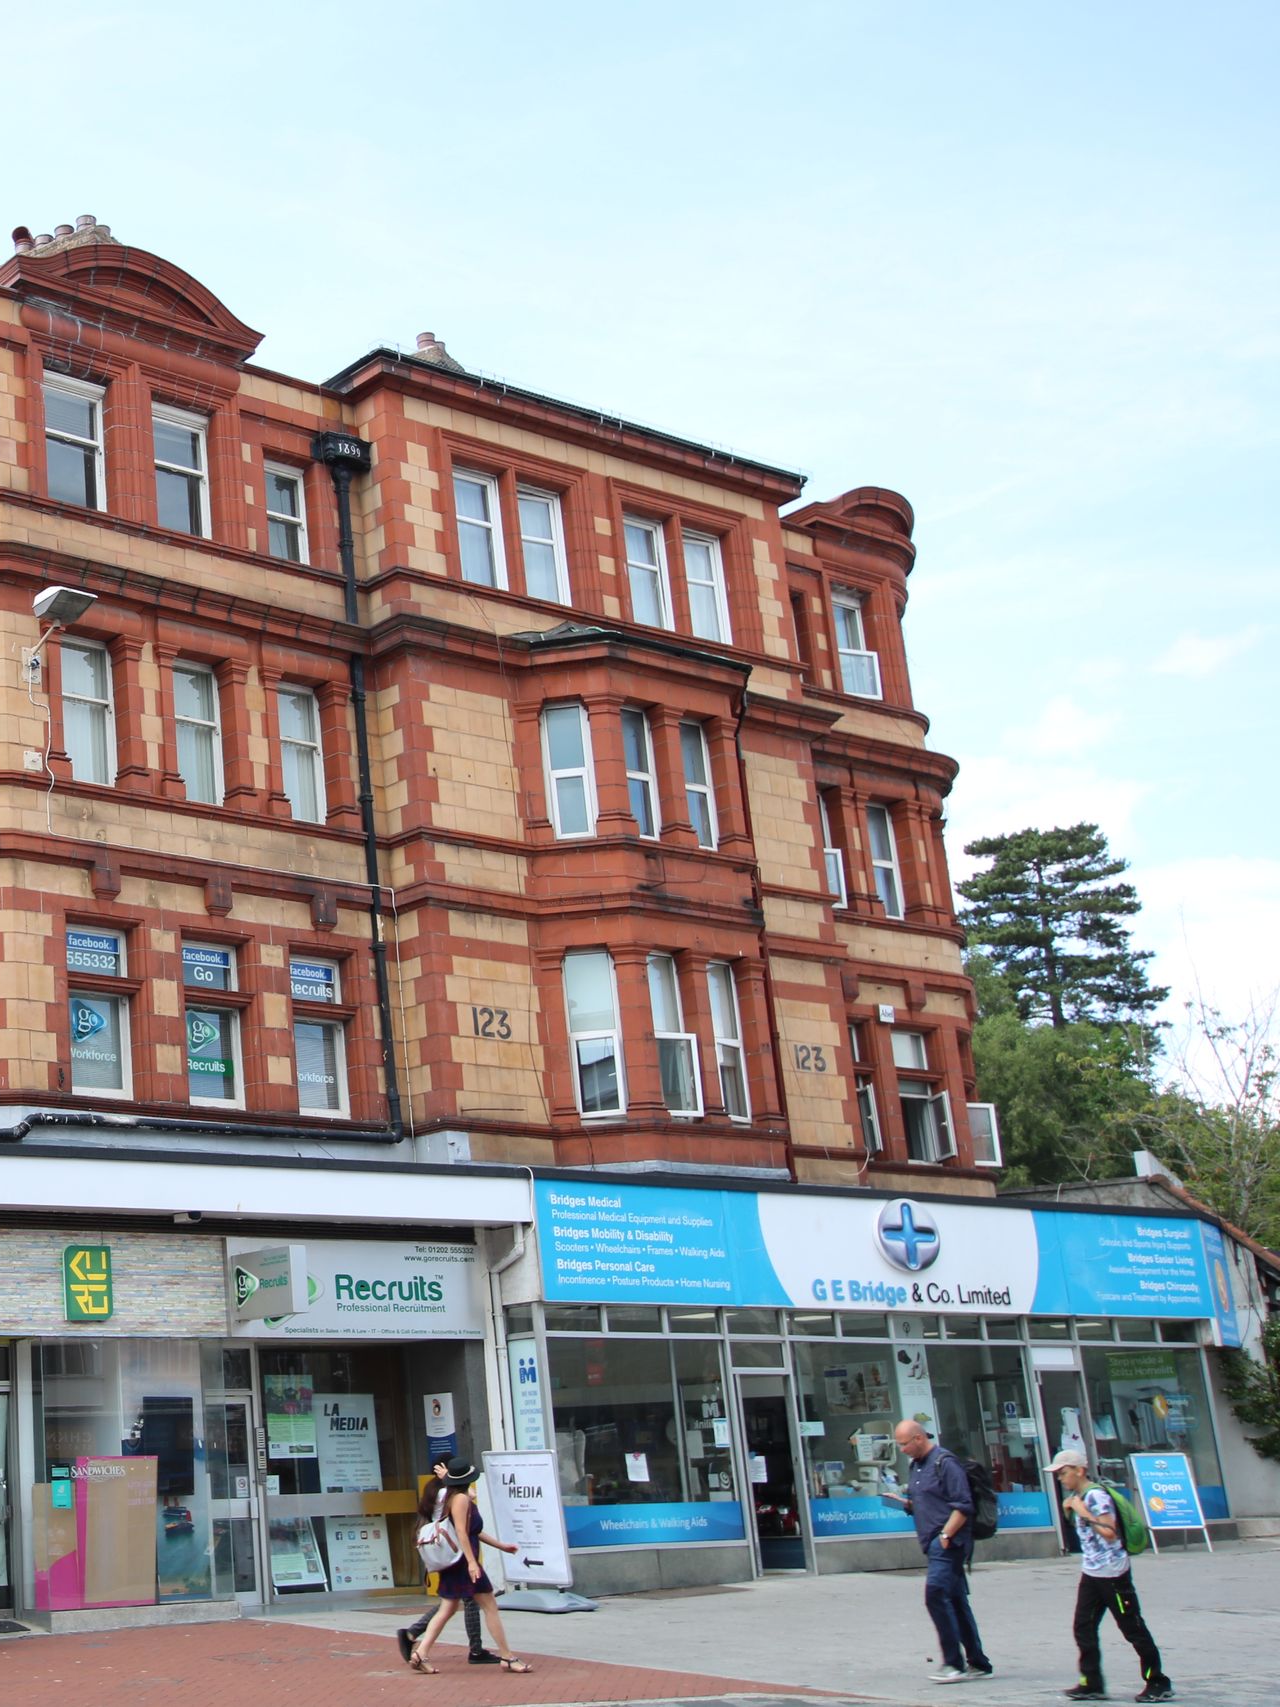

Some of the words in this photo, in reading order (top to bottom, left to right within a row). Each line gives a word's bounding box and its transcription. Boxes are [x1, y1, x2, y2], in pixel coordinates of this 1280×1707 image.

[338, 443, 360, 458] 1899
[67, 951, 116, 970] 555332
[194, 967, 213, 982] Go
[78, 1008, 98, 1033] go
[472, 1006, 512, 1040] 123
[192, 1019, 210, 1043] go
[794, 1044, 827, 1073] 123
[297, 1071, 334, 1084] orkforce
[550, 1194, 586, 1207] Bridges
[588, 1196, 621, 1208] Medical
[551, 1209, 596, 1220] Professional
[598, 1211, 627, 1222] Medical
[628, 1213, 666, 1225] Equipment
[667, 1215, 681, 1225] and
[682, 1215, 713, 1228] Supplies
[553, 1226, 589, 1239] Bridges
[591, 1228, 625, 1242] Mobility
[626, 1230, 633, 1240] &
[635, 1230, 674, 1244] Disability
[1137, 1226, 1163, 1238] Bridges
[1164, 1228, 1190, 1239] Surgical
[428, 1246, 448, 1254] 01202
[554, 1241, 589, 1252] Scooters
[595, 1243, 641, 1255] Wheelchairs
[647, 1245, 673, 1255] Frames
[678, 1246, 708, 1259] Walking
[709, 1248, 725, 1258] Aids
[404, 1255, 475, 1264] www.gorecruits.com
[557, 1258, 592, 1272] Bridges
[595, 1260, 632, 1272] Personal
[634, 1261, 655, 1272] Care
[1128, 1253, 1154, 1265] Bridges
[1154, 1254, 1174, 1264] Easier
[1175, 1256, 1195, 1266] Living
[1133, 1266, 1161, 1276] Equipment
[260, 1275, 288, 1289] Recruits
[335, 1274, 443, 1301] Recruits
[558, 1274, 605, 1285] Incontinence
[612, 1276, 640, 1286] Posture
[642, 1276, 674, 1287] Products
[680, 1279, 702, 1288] Home
[703, 1279, 731, 1291] Nursing
[1140, 1280, 1165, 1292] Bridges
[1166, 1281, 1199, 1293] Chiropody
[812, 1278, 827, 1302] G
[831, 1279, 845, 1301] E
[848, 1279, 907, 1307] Bridge
[912, 1282, 924, 1303] &
[927, 1282, 954, 1304] Co.
[957, 1284, 1011, 1306] Limited
[337, 1303, 390, 1313] Professional
[393, 1303, 446, 1313] Recruitment
[323, 1403, 340, 1417] LA
[330, 1417, 369, 1431] MEDIA
[70, 1465, 126, 1479] SANDWICHES
[502, 1473, 516, 1485] LA
[508, 1486, 543, 1499] MEDIA
[1152, 1482, 1182, 1494] Open
[818, 1511, 847, 1523] Mobility
[848, 1510, 879, 1520] Scooters
[880, 1510, 886, 1518] &
[1009, 1505, 1040, 1515] Orthotics
[600, 1518, 649, 1531] Wheelchairs
[651, 1518, 658, 1529] &
[659, 1517, 690, 1531] Walking
[691, 1515, 708, 1527] Aids
